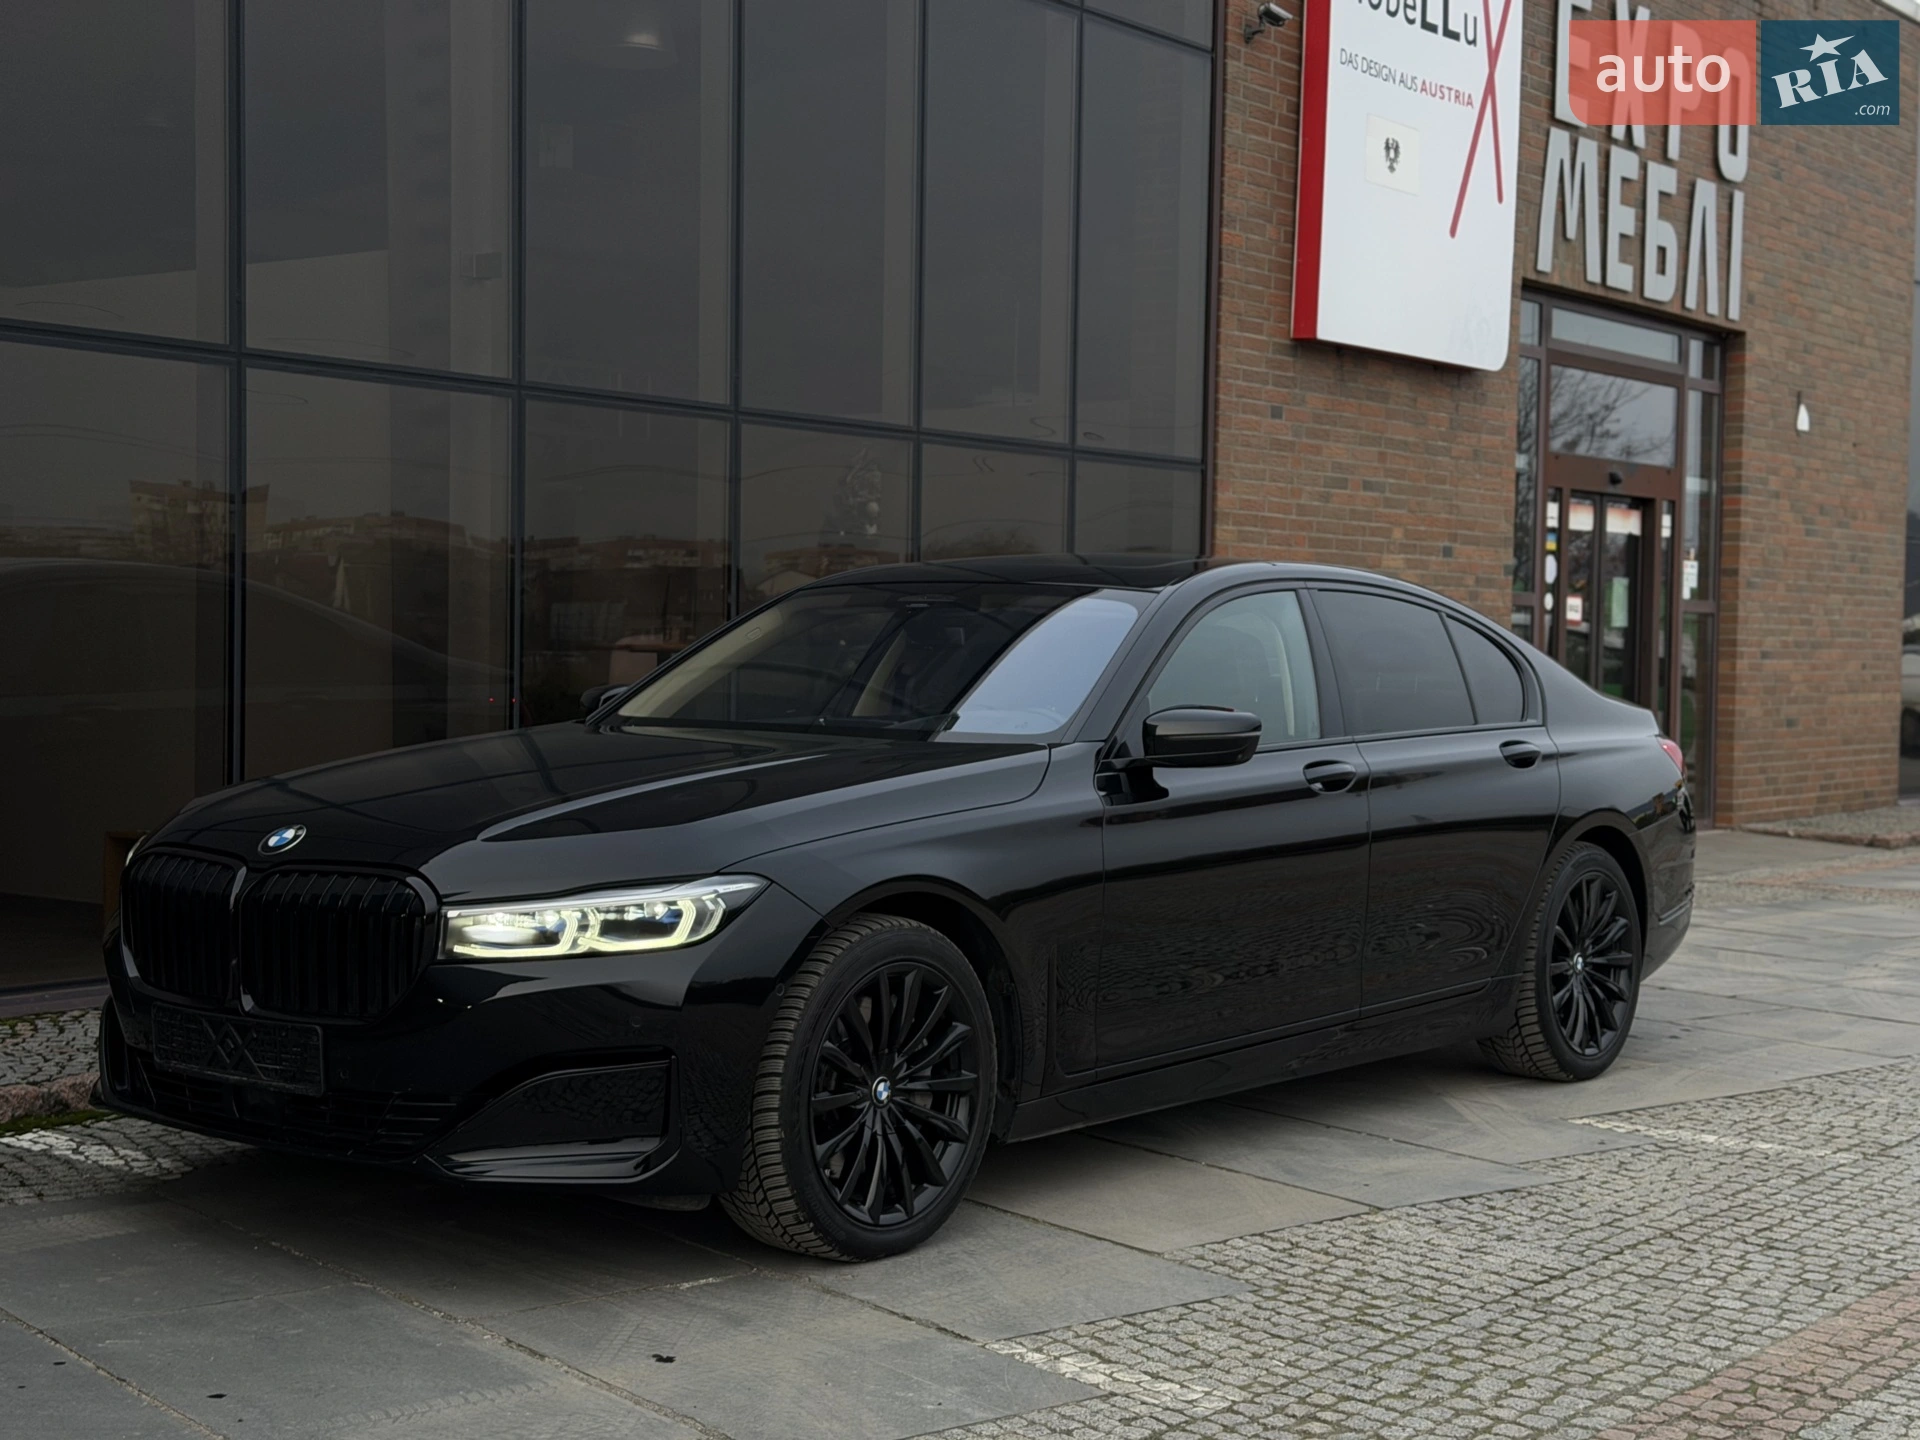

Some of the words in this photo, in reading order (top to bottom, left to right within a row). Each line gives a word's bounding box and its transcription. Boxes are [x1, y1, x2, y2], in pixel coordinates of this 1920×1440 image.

[1340, 48, 1359, 71] DAS
[1361, 57, 1397, 85] DESIGN
[1399, 72, 1418, 93] AUS
[1420, 79, 1474, 109] AUSTRIA
[1536, 126, 1745, 322] МЕБЛІ
